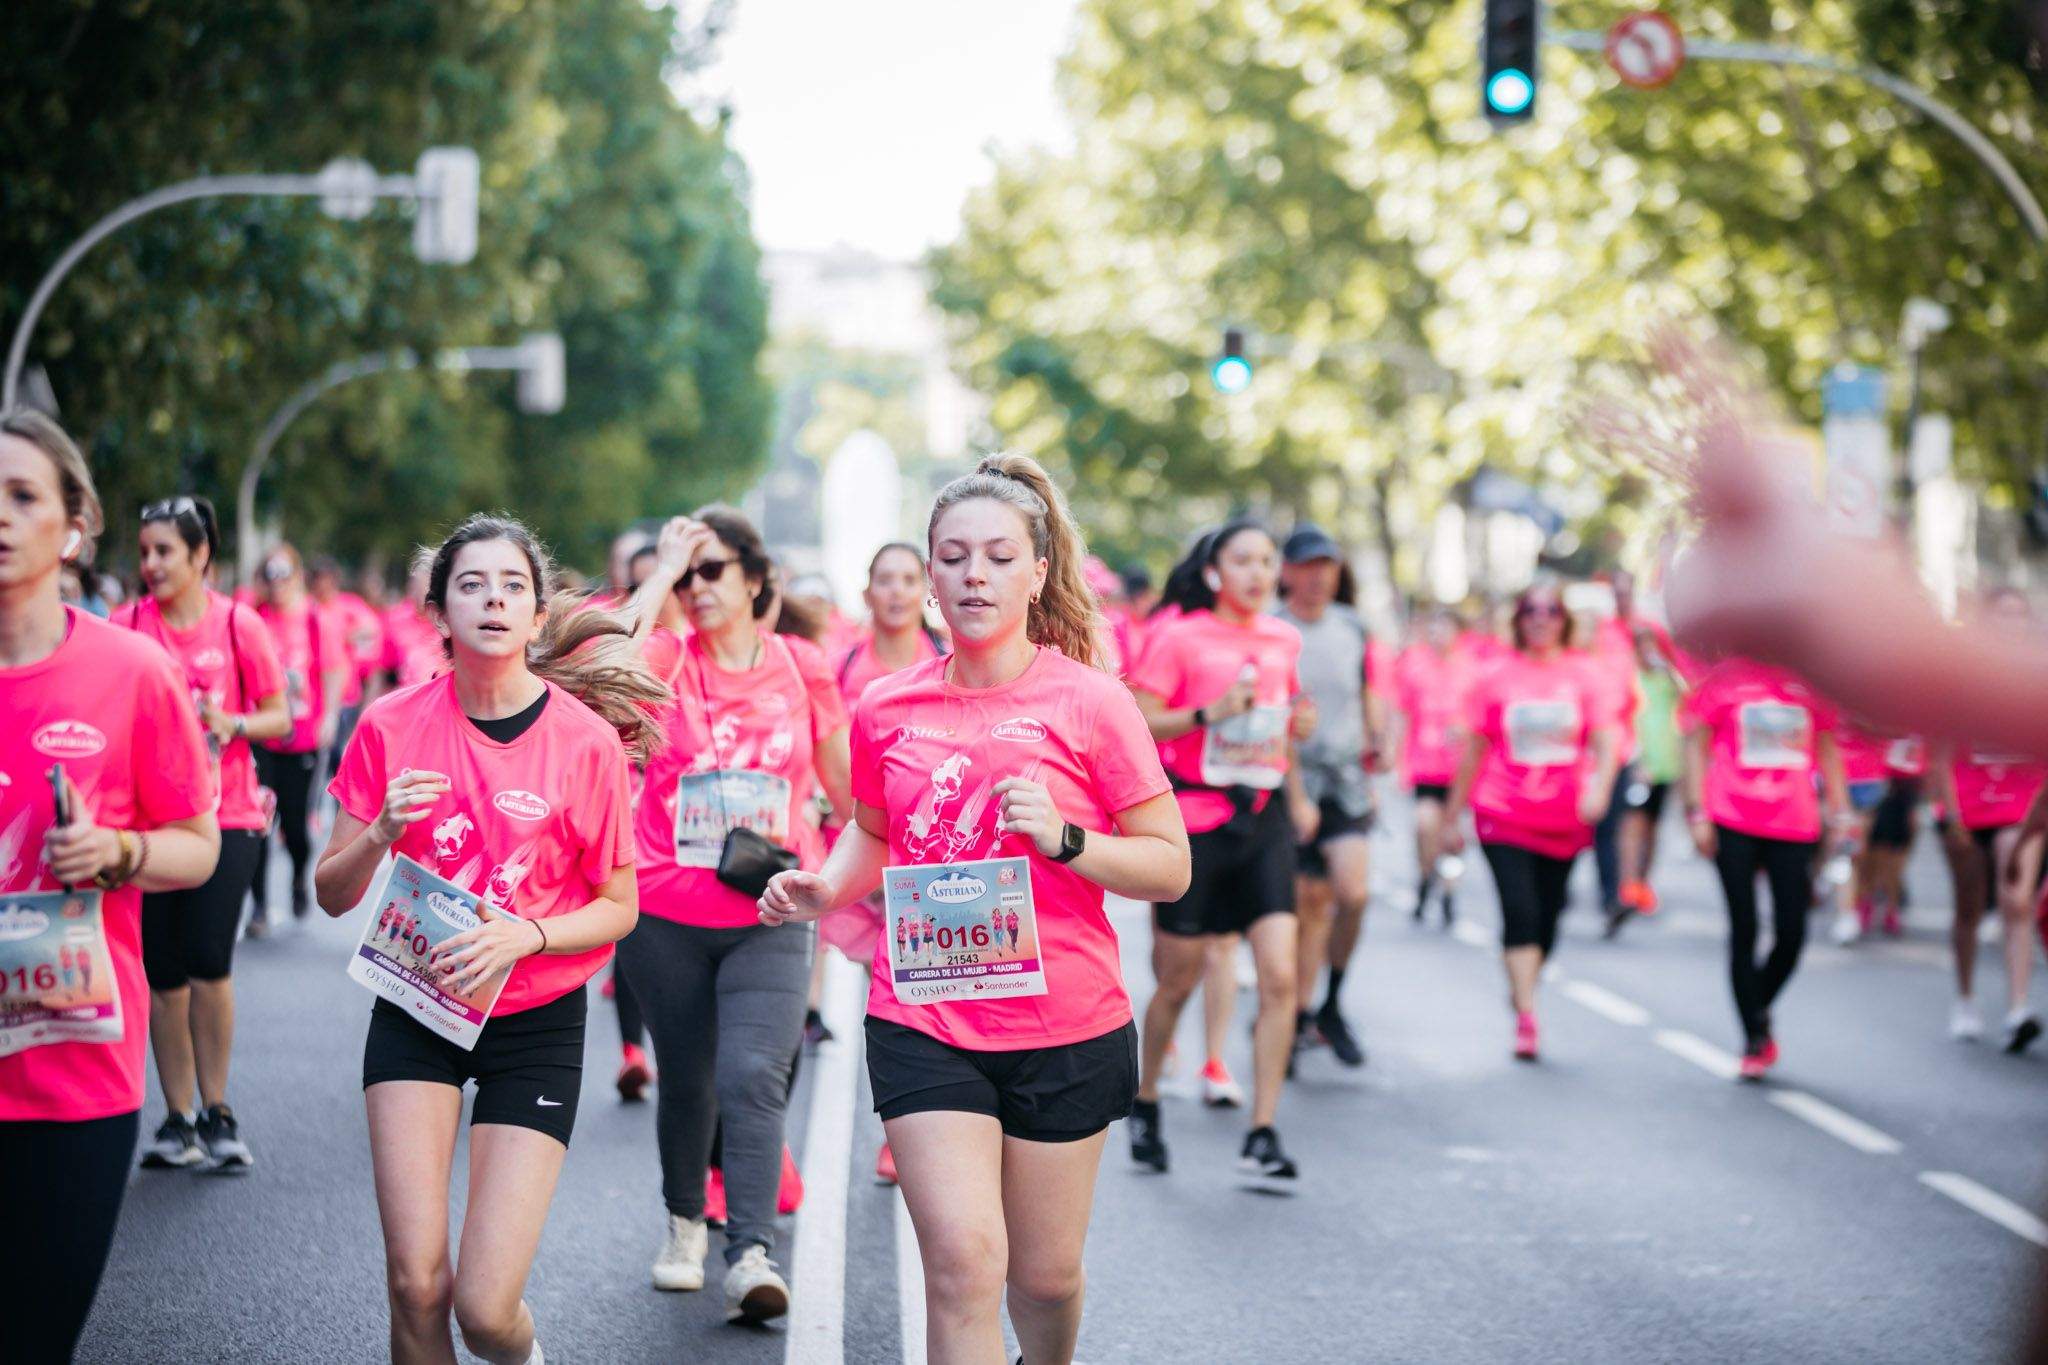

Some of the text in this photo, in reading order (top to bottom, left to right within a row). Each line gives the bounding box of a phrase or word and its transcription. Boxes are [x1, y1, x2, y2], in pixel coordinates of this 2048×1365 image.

[997, 727, 1042, 738] ASTURIANA
[497, 796, 545, 815] ASTURIANA
[895, 881, 916, 890] SUMA
[931, 885, 983, 897] ASTURIANA
[937, 925, 990, 949] 016
[947, 954, 979, 965] 21543
[909, 969, 940, 979] CARRERA
[942, 969, 951, 978] DE
[952, 968, 962, 976] LA
[963, 966, 987, 975] MUJER
[993, 963, 1023, 972] MADRID
[366, 967, 405, 996] OYSHO
[374, 953, 402, 977] CARRERA
[401, 968, 412, 980] DE
[411, 974, 420, 986] LA
[420, 979, 440, 998] MUJER
[442, 996, 468, 1015] MADRID
[984, 981, 1029, 990] Santander
[911, 984, 956, 996] OYSHO
[425, 1005, 462, 1033] Santander
